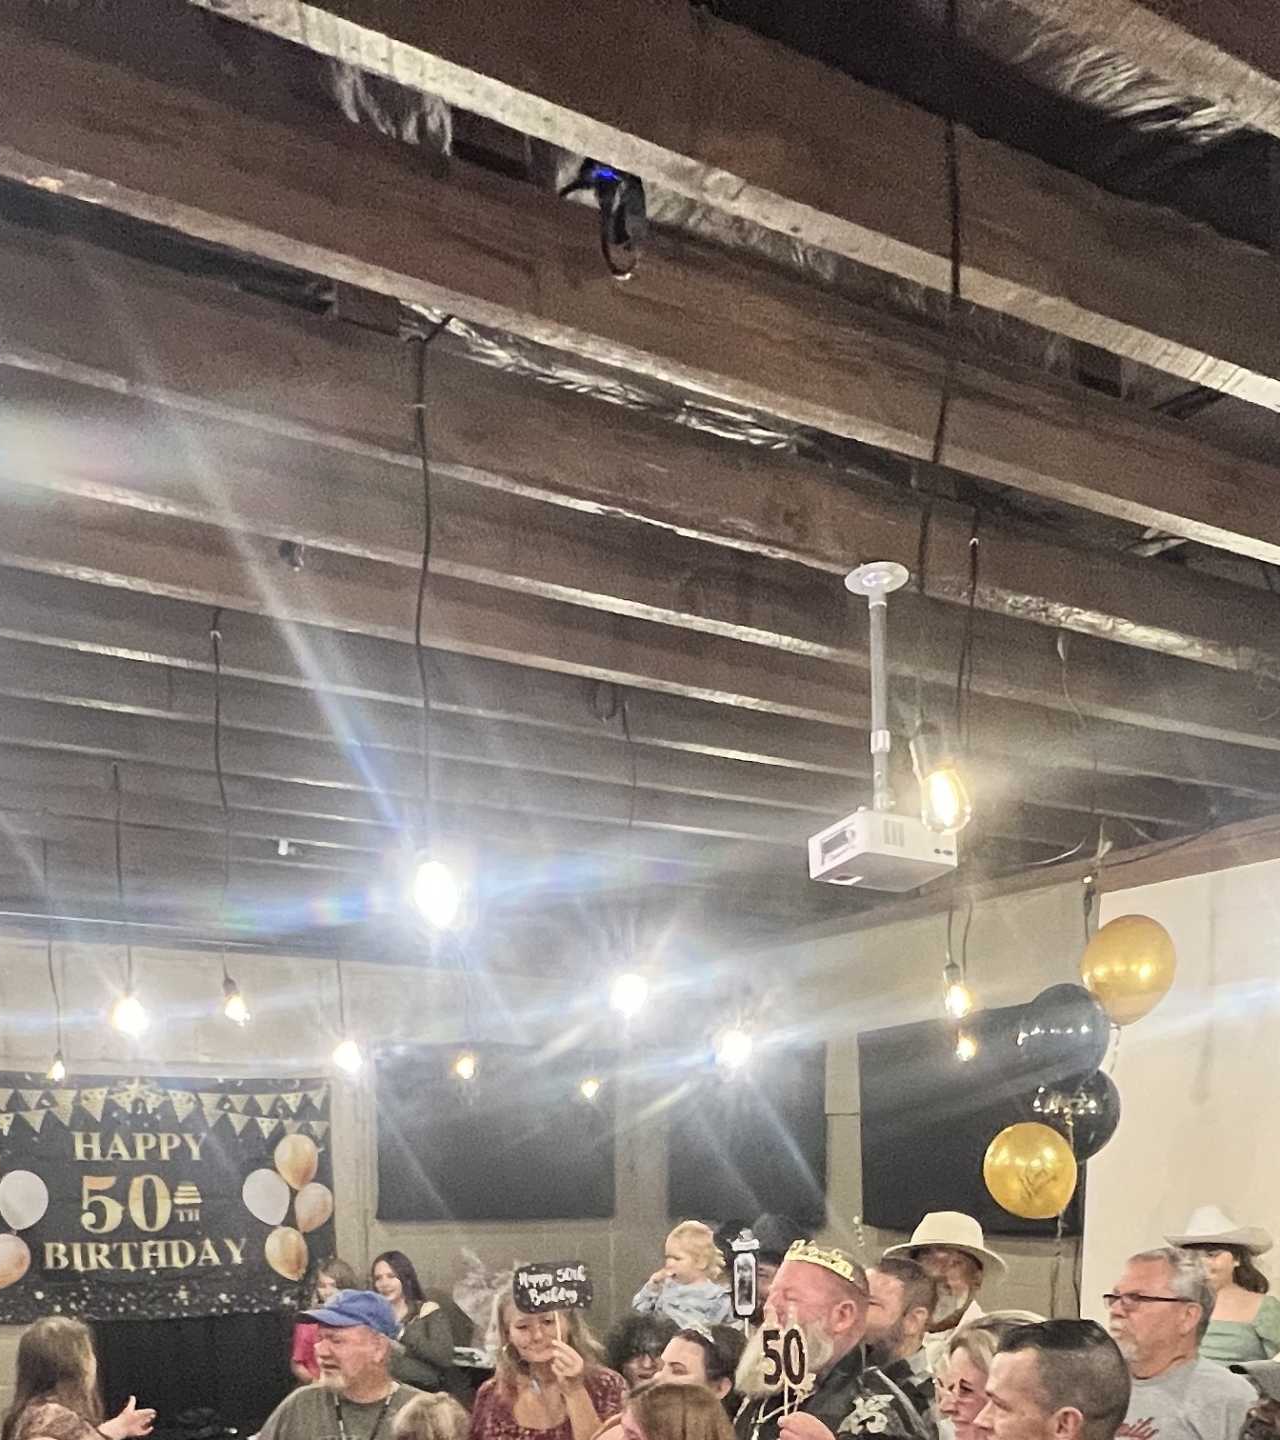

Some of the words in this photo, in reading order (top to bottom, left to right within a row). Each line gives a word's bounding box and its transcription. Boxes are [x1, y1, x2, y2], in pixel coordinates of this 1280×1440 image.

[73, 1132, 206, 1162] HAPPY
[81, 1174, 172, 1234] 50
[44, 1238, 246, 1273] BIRTHDAY
[761, 1328, 807, 1386] 50
